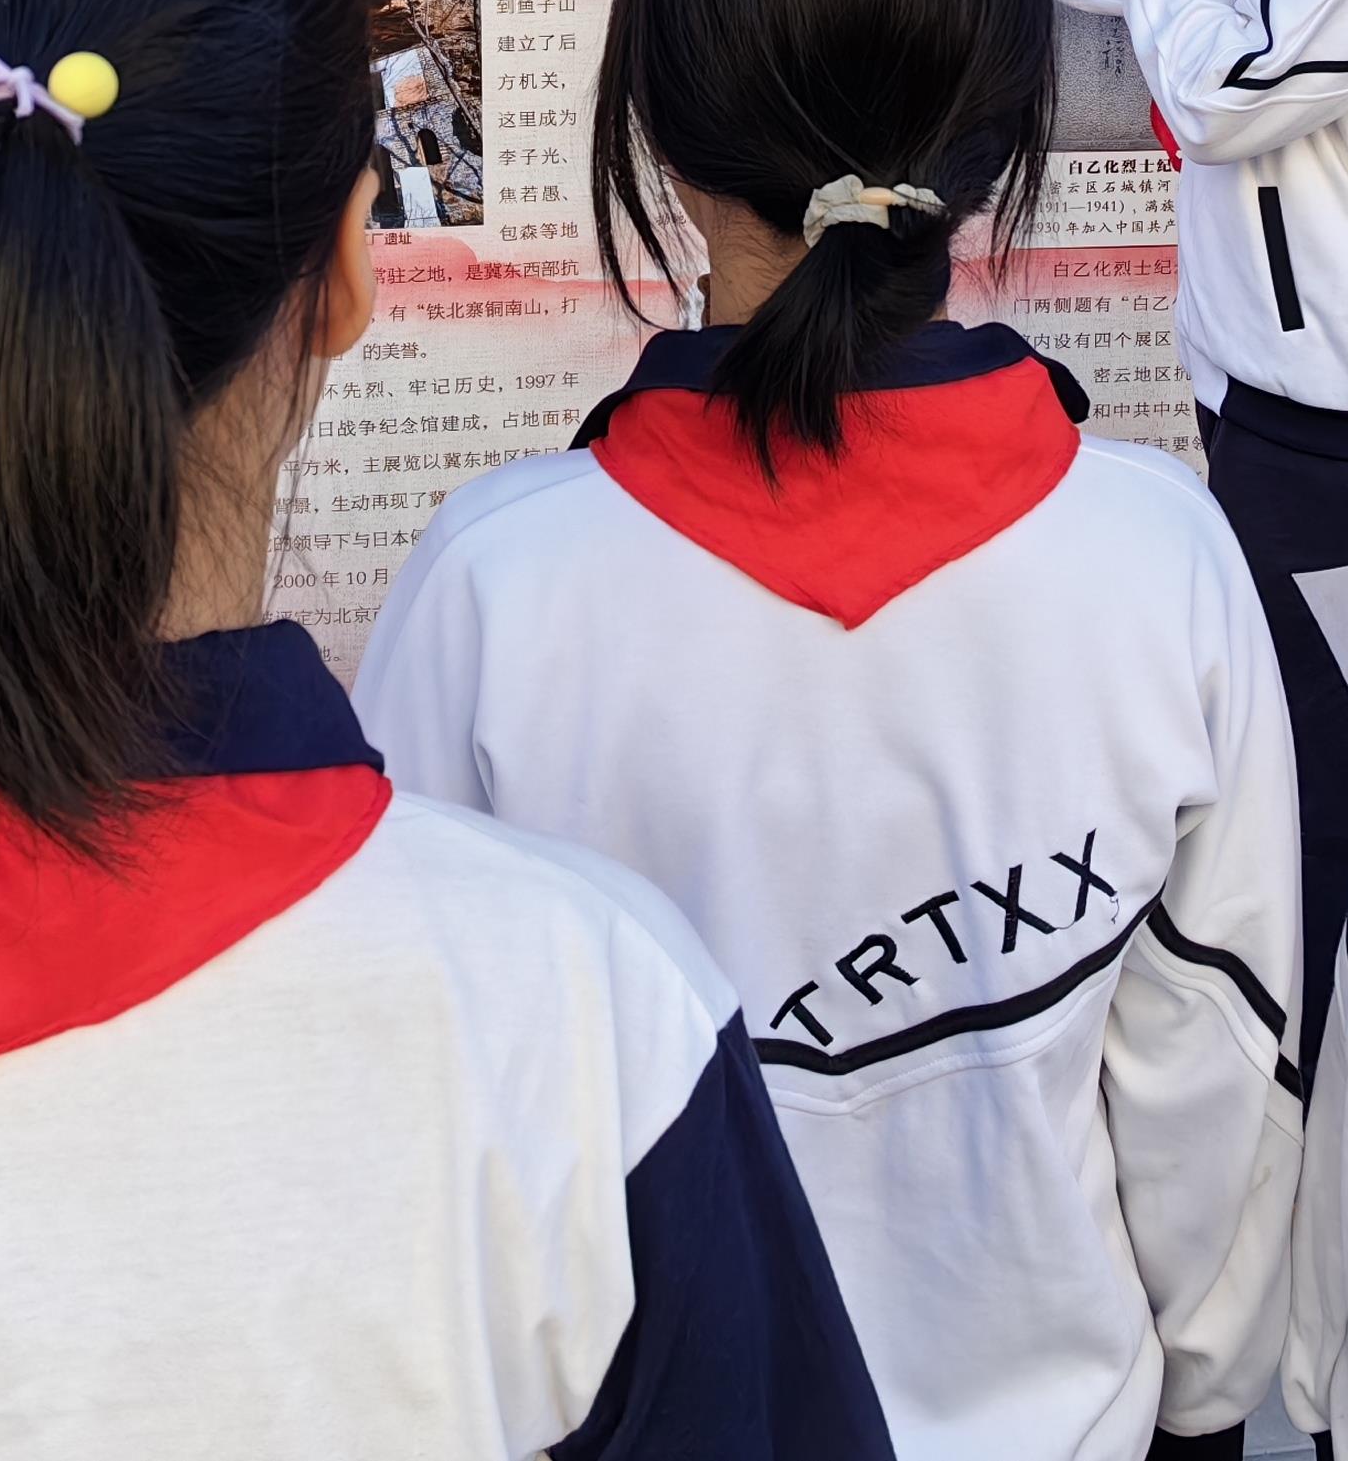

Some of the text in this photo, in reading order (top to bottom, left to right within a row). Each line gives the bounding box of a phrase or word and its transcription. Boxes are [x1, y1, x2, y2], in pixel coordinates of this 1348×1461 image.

[497, 33, 577, 52] 建立了后
[497, 71, 567, 91] 方机关，
[498, 109, 578, 128] 这里成为
[498, 147, 573, 166] 李子光、
[500, 221, 579, 241] 包森等地
[1054, 259, 1178, 278] 白乙化烈士纪
[1021, 330, 1172, 350] 内设有四个展区
[1092, 400, 1190, 419] 和中共中央
[769, 828, 1117, 1047] TRTXX
